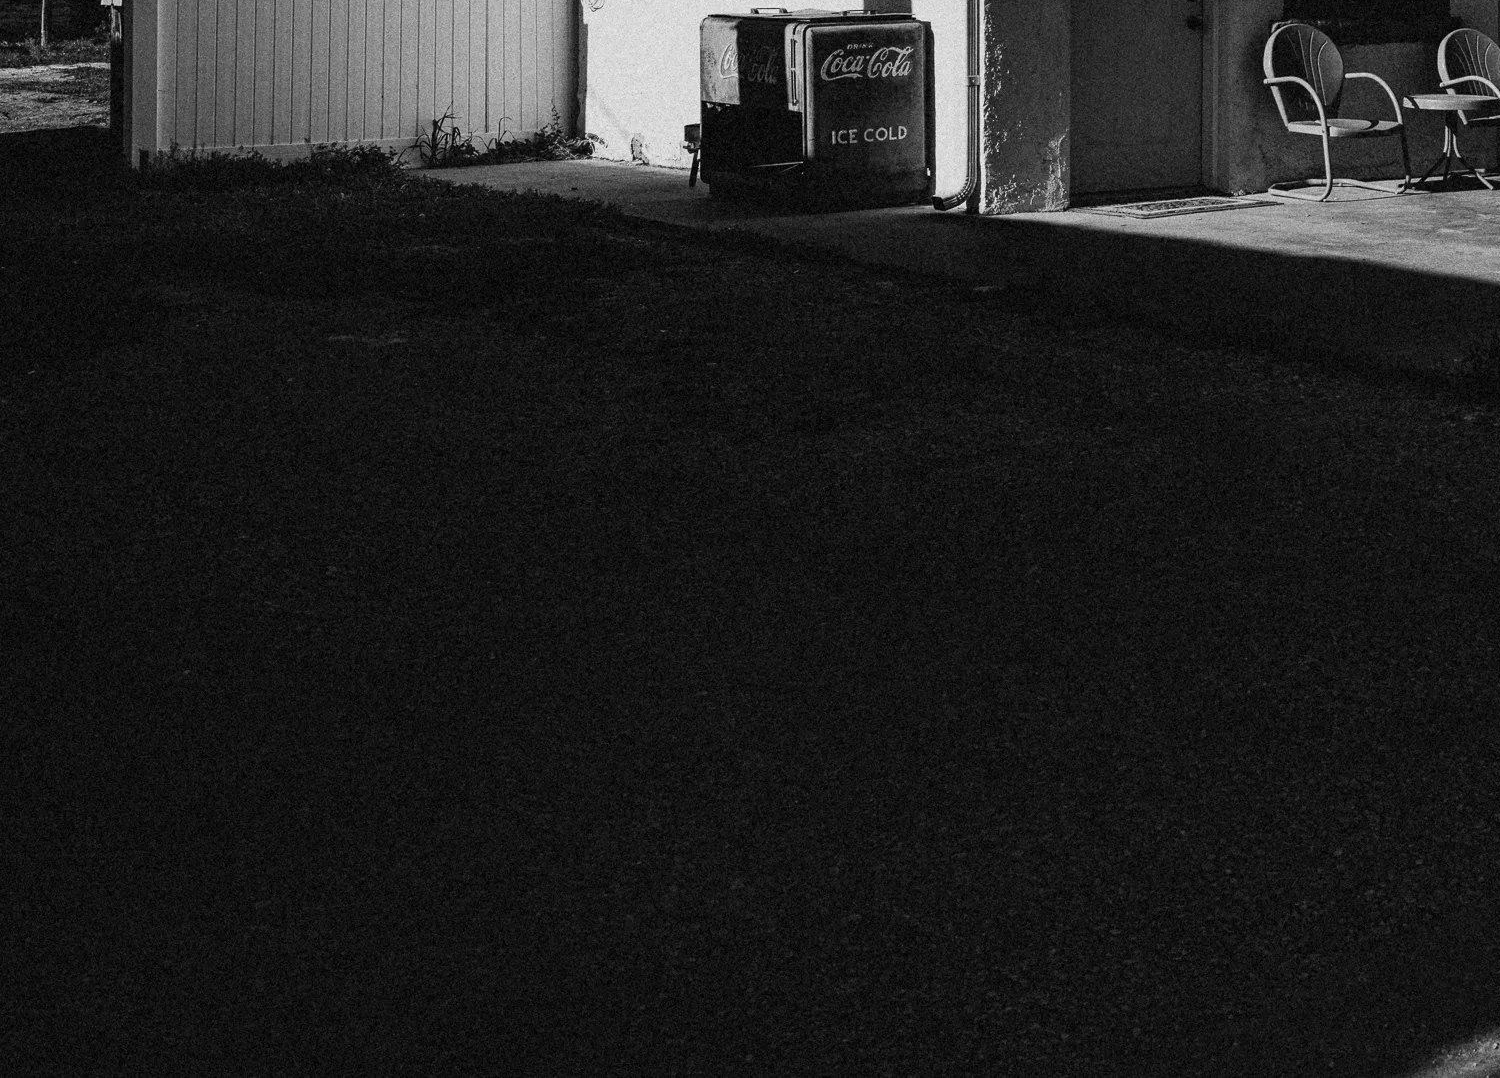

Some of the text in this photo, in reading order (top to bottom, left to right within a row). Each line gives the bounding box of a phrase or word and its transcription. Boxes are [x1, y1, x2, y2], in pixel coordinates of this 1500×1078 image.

[820, 46, 915, 81] Coca-Cola
[830, 125, 908, 146] ICE COLD
